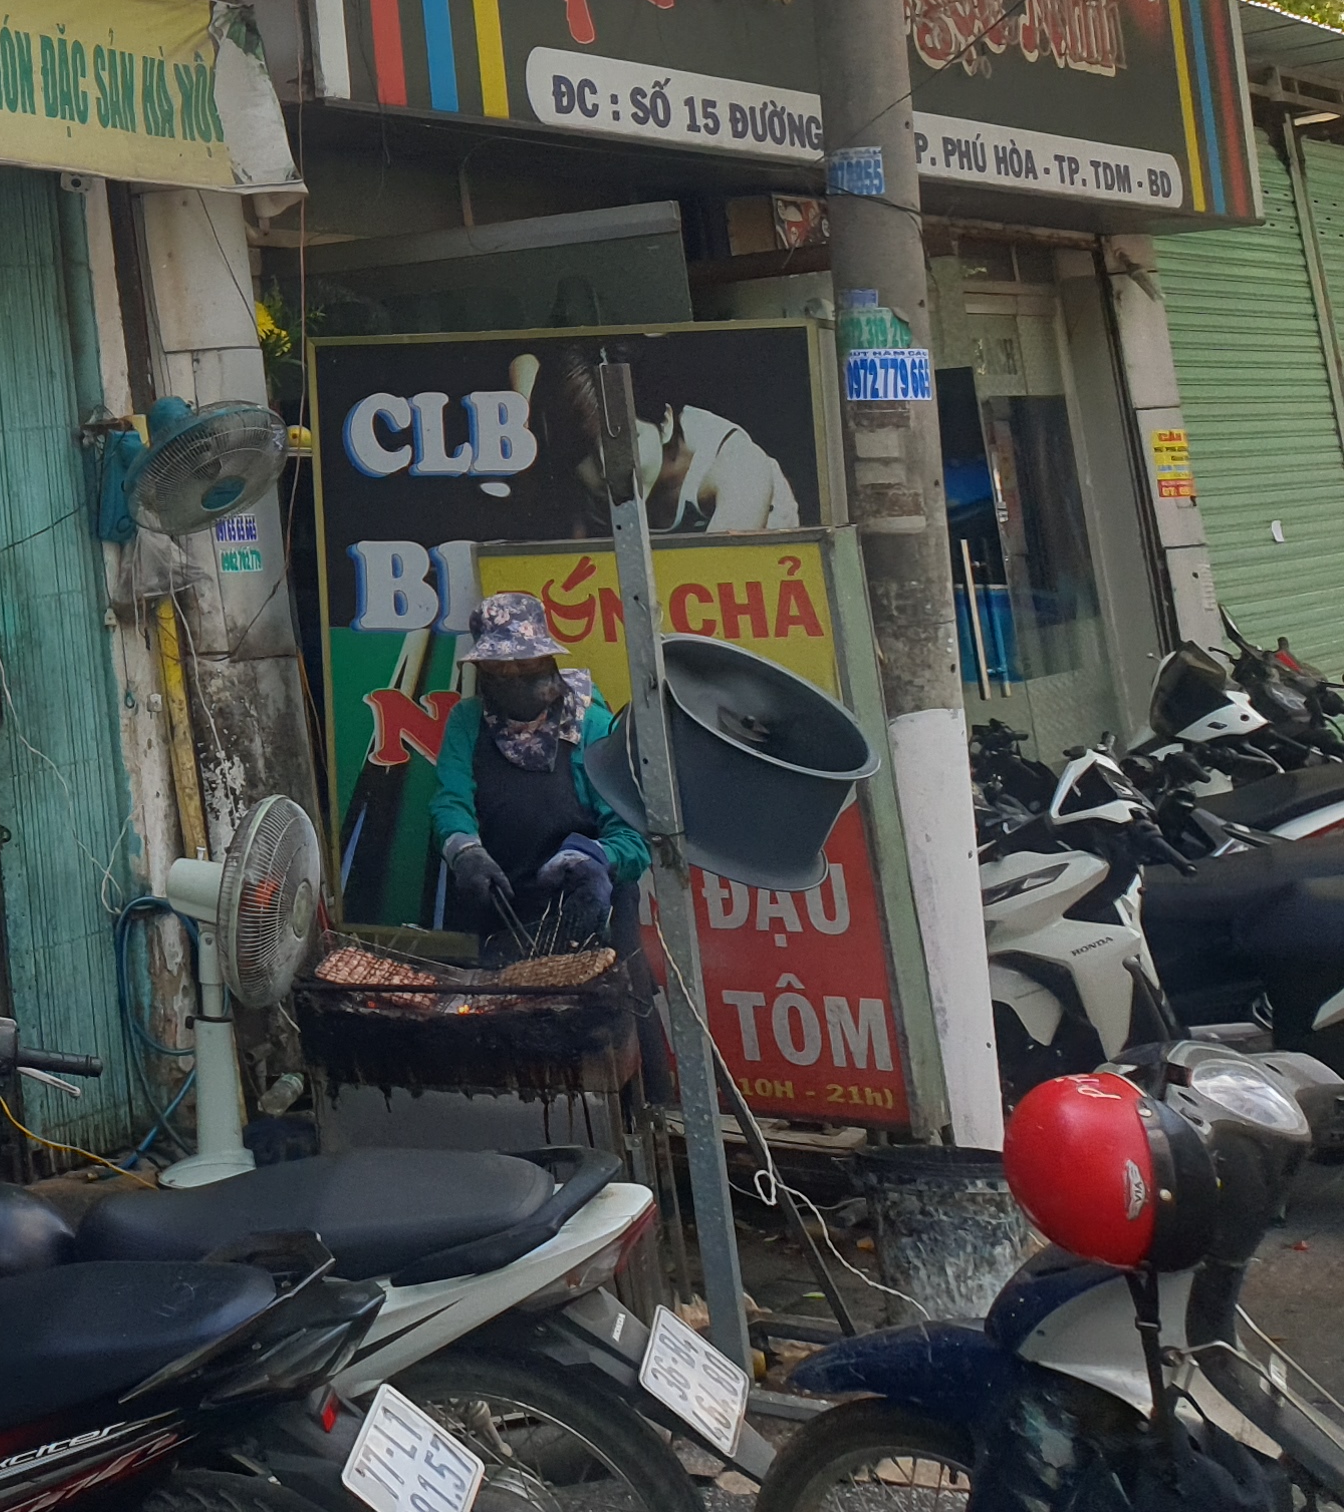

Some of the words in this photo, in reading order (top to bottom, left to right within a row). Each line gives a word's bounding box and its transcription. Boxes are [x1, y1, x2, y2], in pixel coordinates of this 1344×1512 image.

[39, 23, 89, 137] ĐẶC
[93, 28, 137, 133] SẢN
[142, 46, 175, 138] HÀ
[630, 78, 672, 128] SỐ
[684, 96, 721, 136] 15
[729, 100, 824, 151] ĐƯỜNG
[942, 133, 987, 173] PHÚ
[994, 139, 1039, 180] HÒA
[1147, 168, 1173, 198] BD
[342, 390, 538, 478] CLB
[668, 556, 825, 640] CHẢ
[1070, 936, 1114, 957] HONDA
[722, 973, 893, 1072] TÔM
